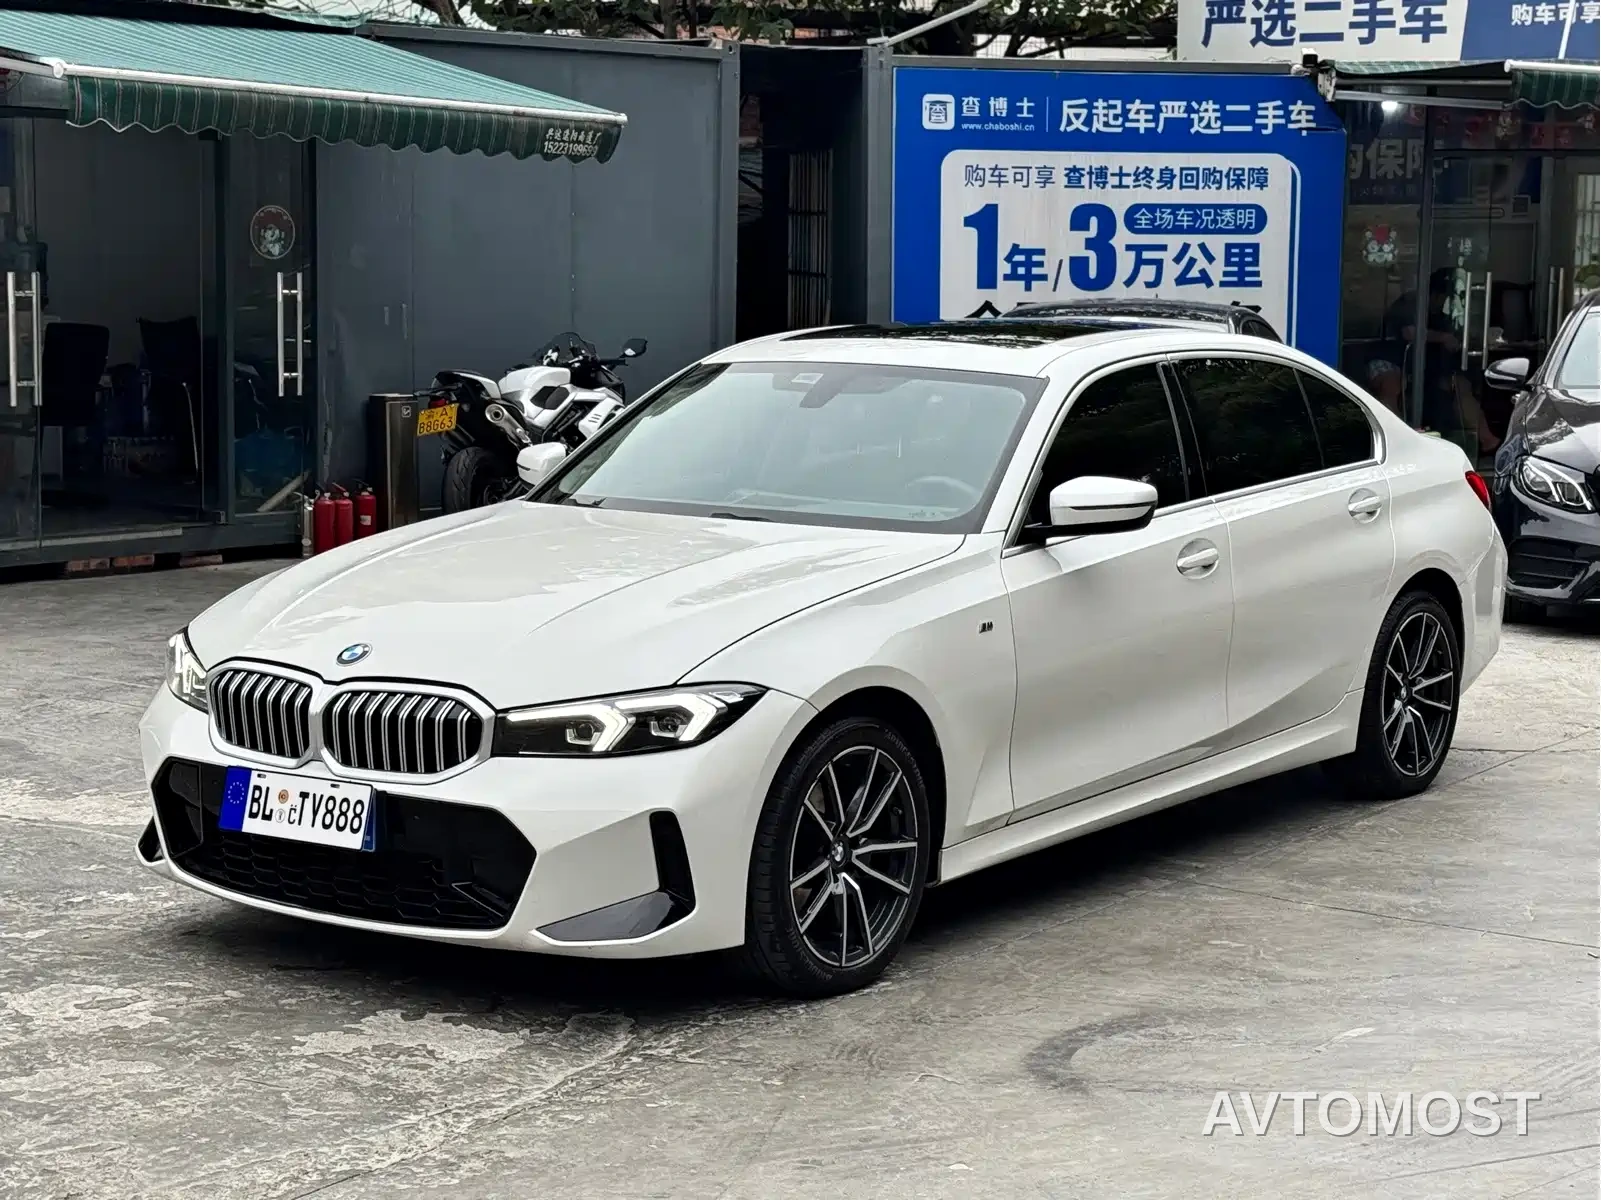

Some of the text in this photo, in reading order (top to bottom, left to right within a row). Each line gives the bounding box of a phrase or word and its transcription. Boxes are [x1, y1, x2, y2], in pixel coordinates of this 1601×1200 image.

[1201, 0, 1448, 48] 严选二手车
[1511, 1, 1600, 26] 购车可享
[961, 96, 1035, 118] 查博士
[1059, 98, 1317, 136] 反起车严选二手车
[961, 121, 1035, 132] www.chaboshi.cn
[964, 164, 1269, 190] 购车可享 查博士终身回购保障
[1133, 207, 1256, 230] 全场车况透明
